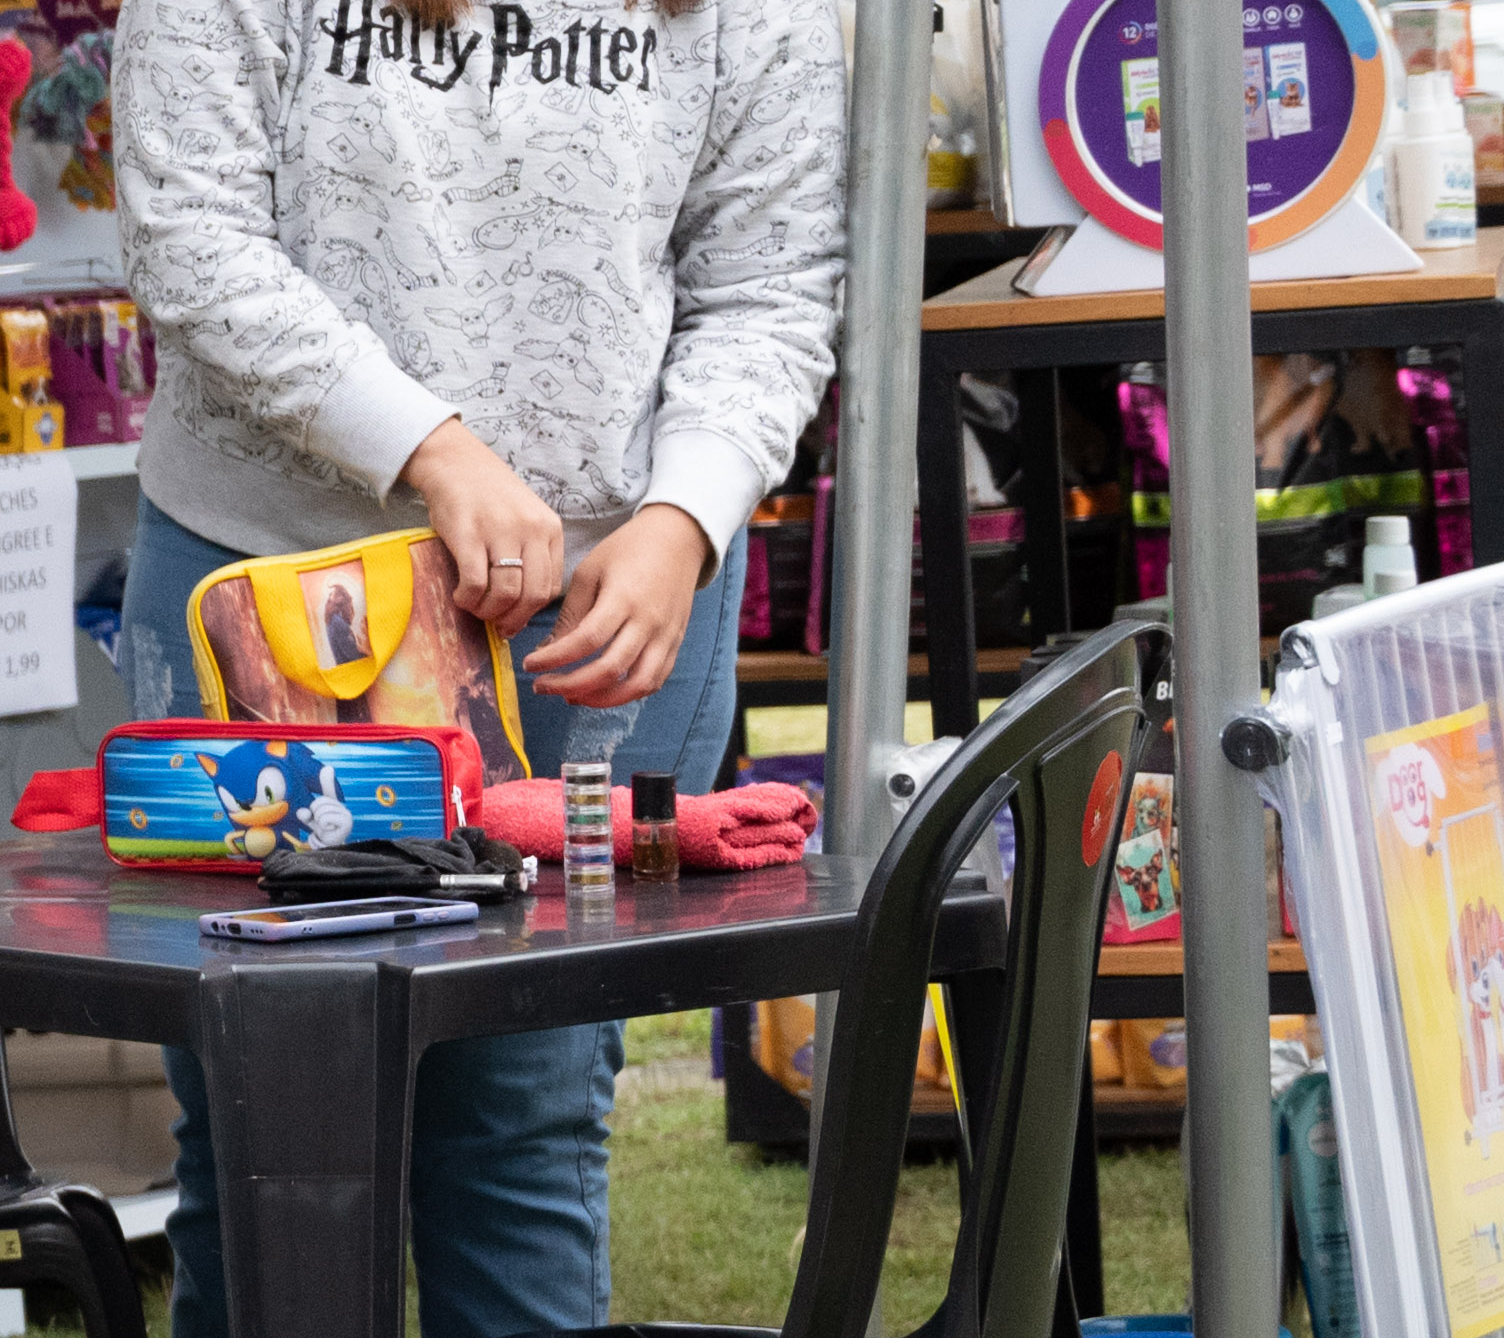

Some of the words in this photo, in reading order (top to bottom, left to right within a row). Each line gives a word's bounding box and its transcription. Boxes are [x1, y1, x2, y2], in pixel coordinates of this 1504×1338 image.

[488, 3, 658, 115] Potter
[44, 524, 54, 548] E
[5, 651, 41, 679] 1,99
